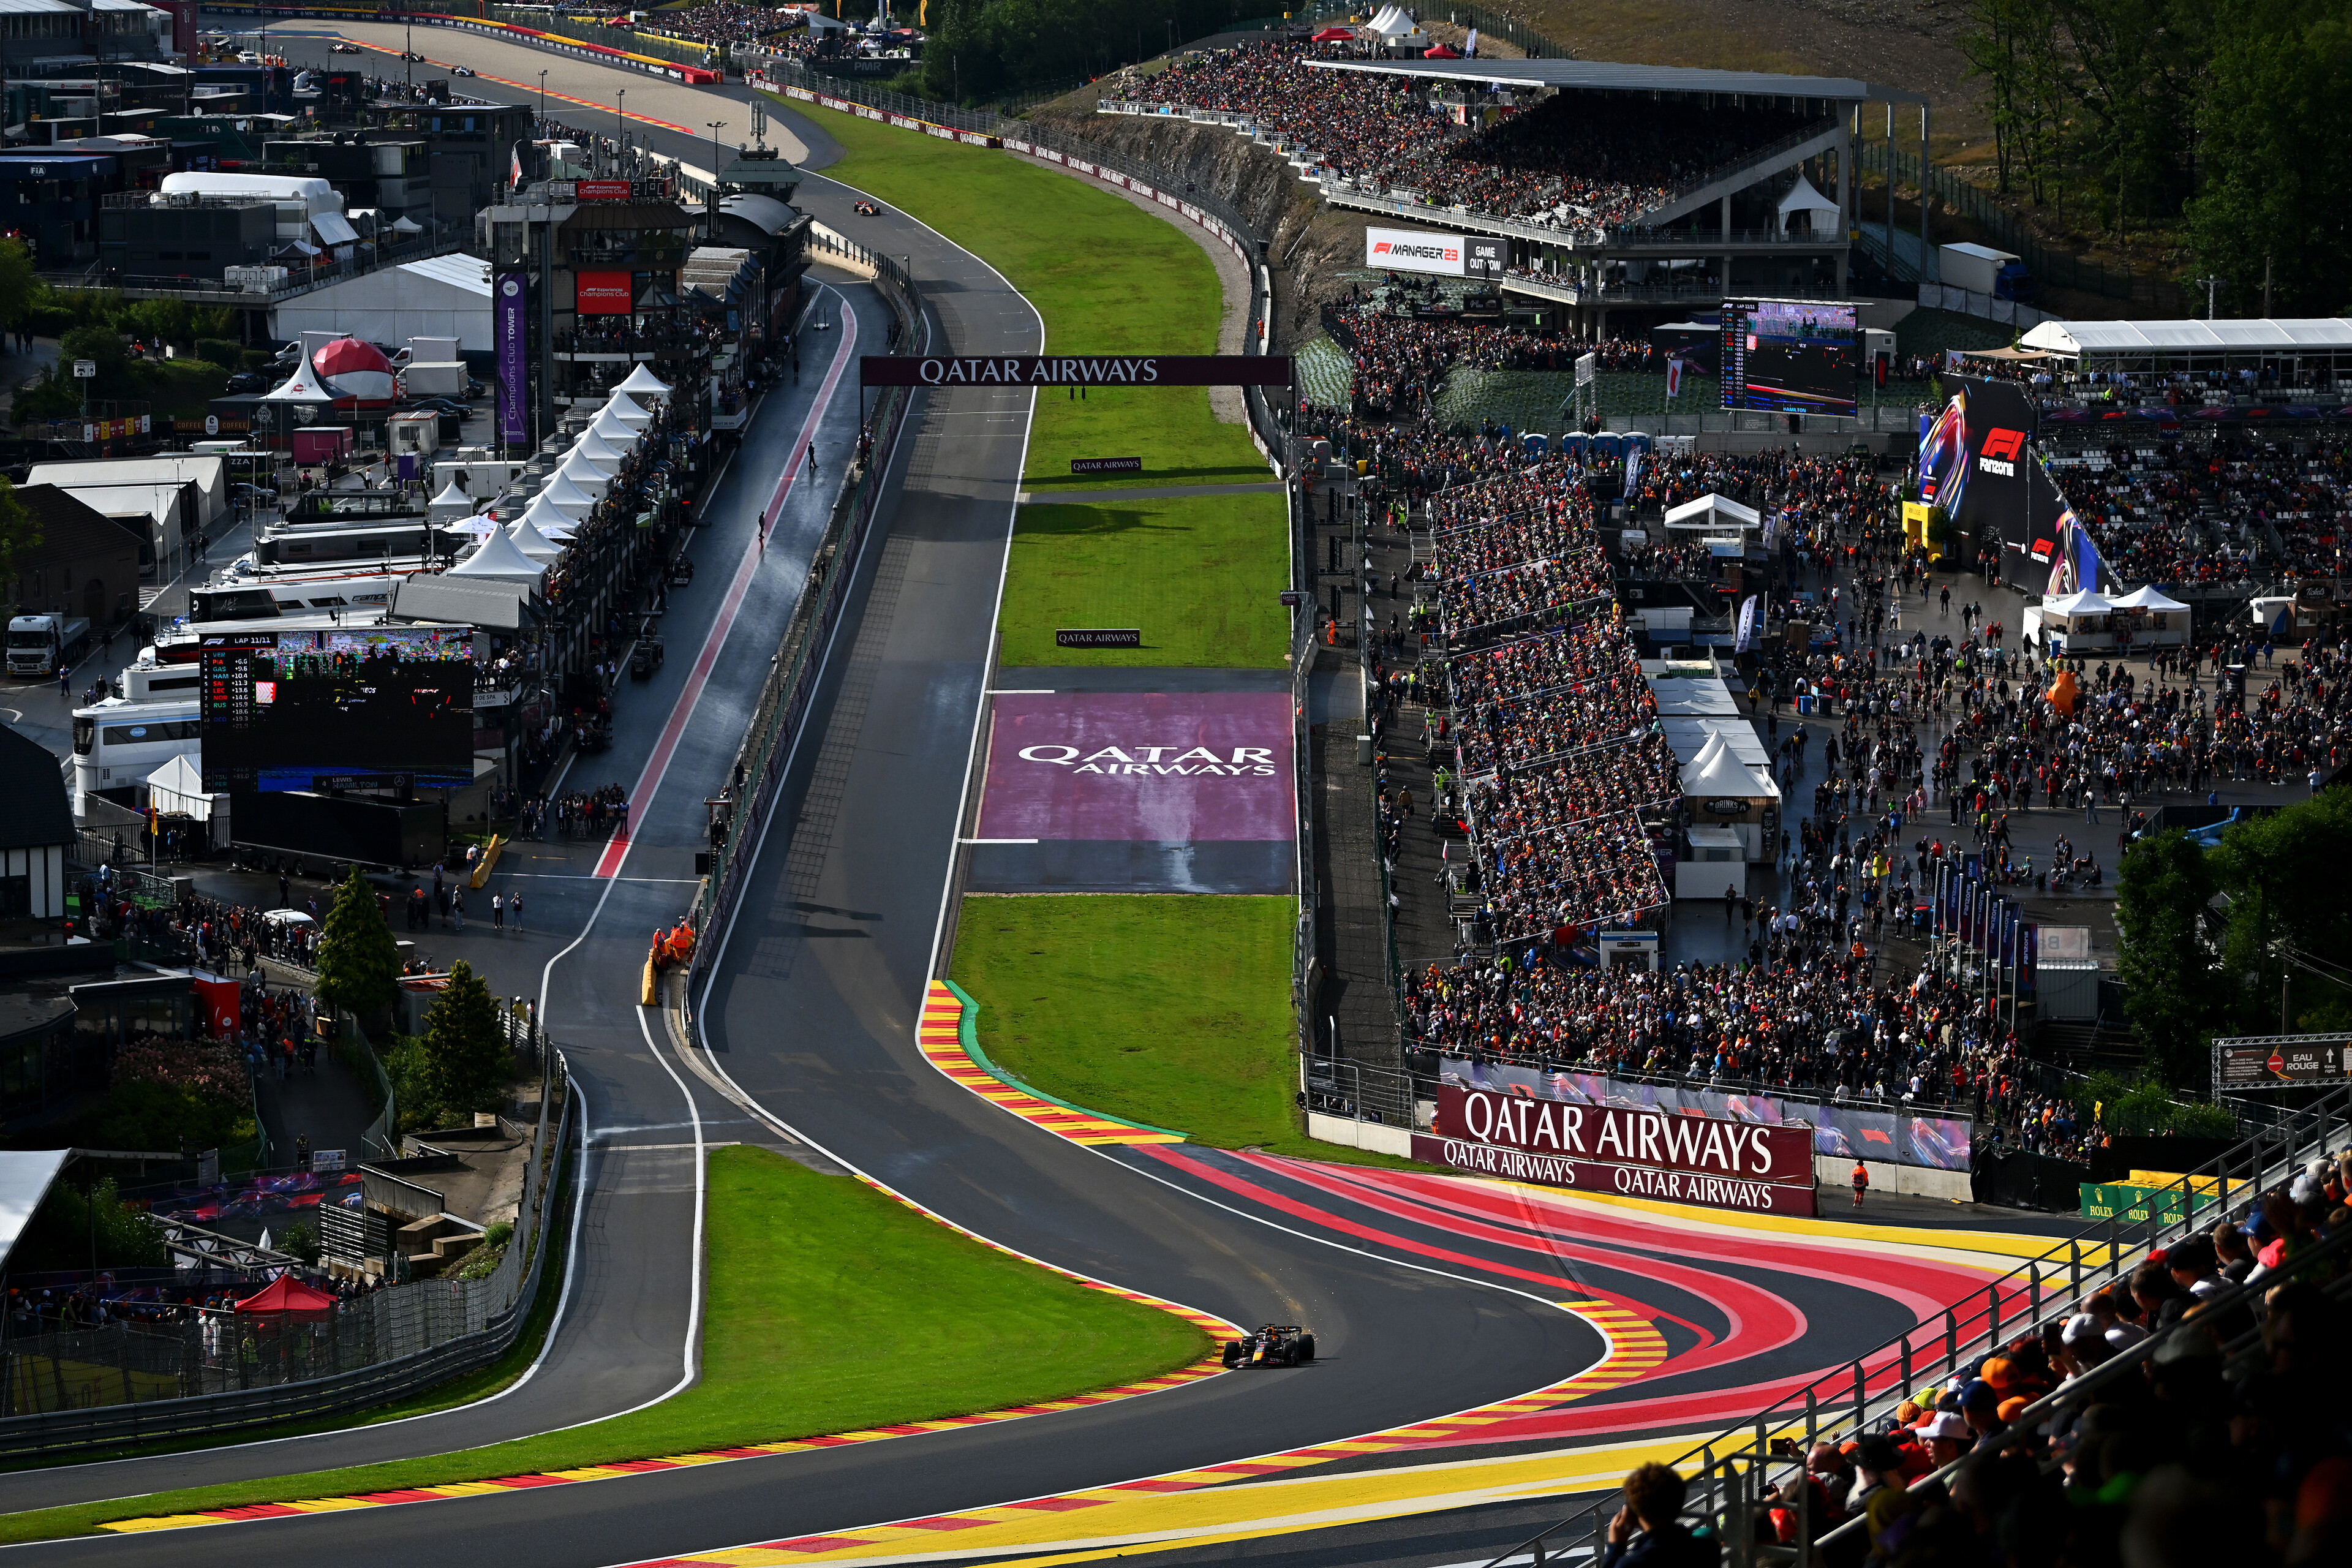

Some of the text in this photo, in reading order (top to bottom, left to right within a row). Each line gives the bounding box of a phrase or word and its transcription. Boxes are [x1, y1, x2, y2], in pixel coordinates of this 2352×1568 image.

[854, 62, 881, 70] PMR
[752, 78, 764, 89] QATAR
[786, 87, 797, 98] QATAR
[820, 96, 833, 107] QATAR
[855, 106, 883, 122] QATAR AIRWAYS
[890, 115, 902, 126] QATAR
[1003, 138, 1015, 148] QATAR
[1035, 146, 1062, 163] QATAR AIRWAYS
[1068, 156, 1079, 168] QATAR
[1391, 244, 1444, 260] MANAGER
[1444, 248, 1458, 261] 23
[1475, 246, 1496, 258] GAME
[1469, 257, 1484, 270] OUT
[919, 359, 1158, 385] QATAR AIRWAYS
[1073, 460, 1139, 470] QATAR AIRWAYS
[1058, 633, 1137, 643] QATAR AIRWAYS
[1018, 745, 1275, 765] QATAR
[1072, 763, 1276, 775] AIRWAYS
[1715, 800, 1738, 809] DRINKS
[2293, 1054, 2312, 1062] EAU
[2286, 1062, 2319, 1071] ROUGE
[1464, 1092, 1772, 1174] QATAR AIRWAYS
[1443, 1141, 1575, 1184] QATAR AIRWAYS
[1614, 1167, 1773, 1209] QATAR AIRWAYS
[2089, 1205, 2114, 1218] ROLEX
